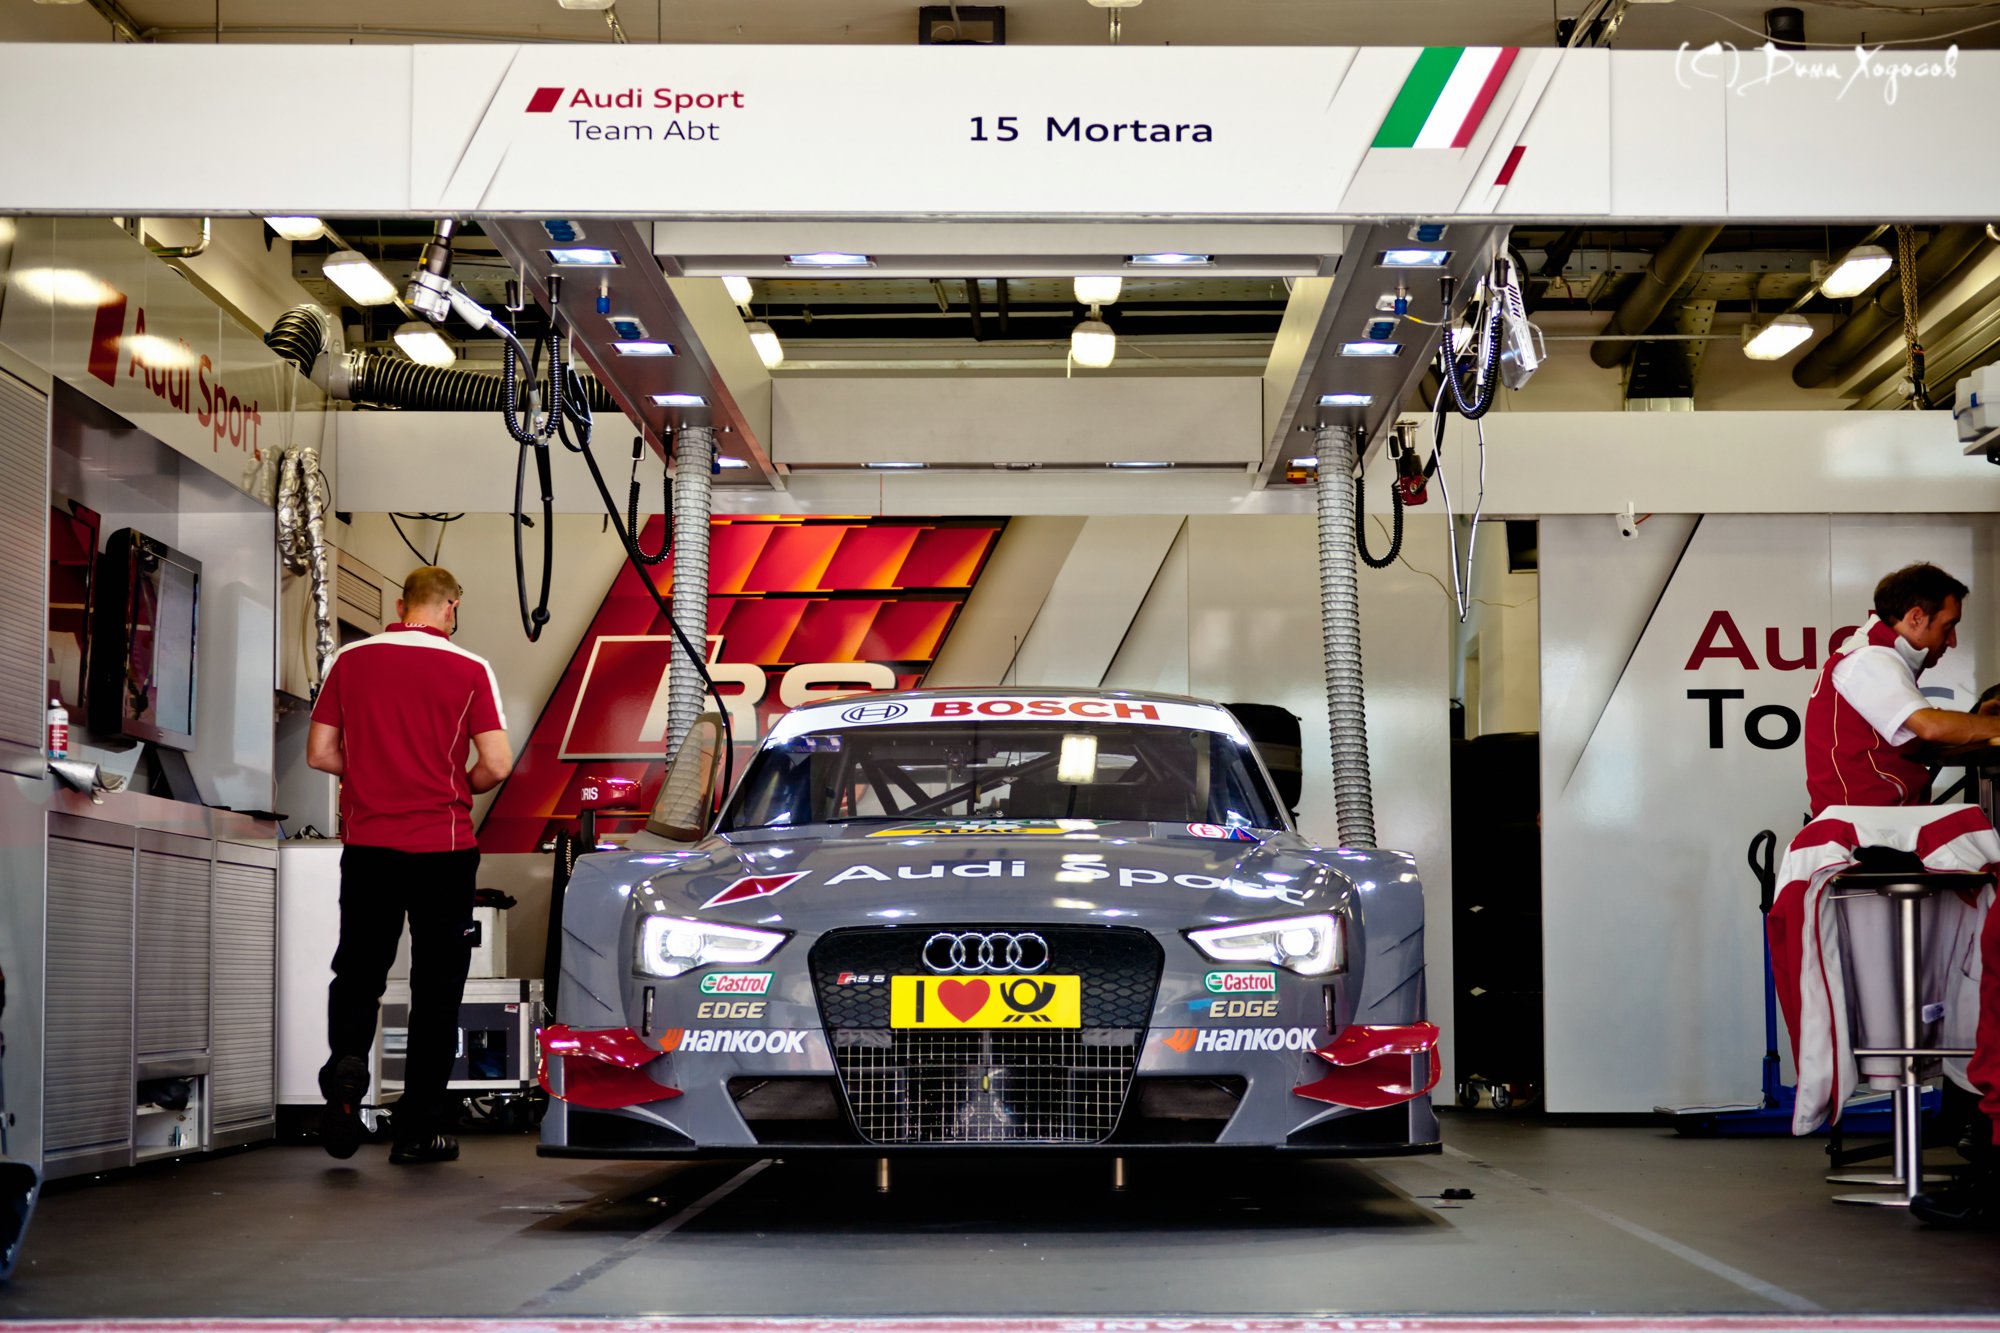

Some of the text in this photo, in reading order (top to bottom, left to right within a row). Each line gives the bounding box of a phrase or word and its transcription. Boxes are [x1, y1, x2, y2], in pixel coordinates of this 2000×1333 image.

[568, 87, 745, 114] Audi Sport
[568, 119, 720, 141] Team Abt
[969, 115, 1214, 144] 15 Mortara
[128, 306, 262, 462] Audi Sport
[929, 700, 1161, 721] BOSCH
[823, 860, 1306, 908] Audi Sport
[715, 974, 769, 993] Castrol
[1224, 973, 1275, 991] Castrol
[696, 1001, 768, 1019] EDGE
[915, 980, 925, 1023] I
[1208, 1000, 1280, 1018] EDGE
